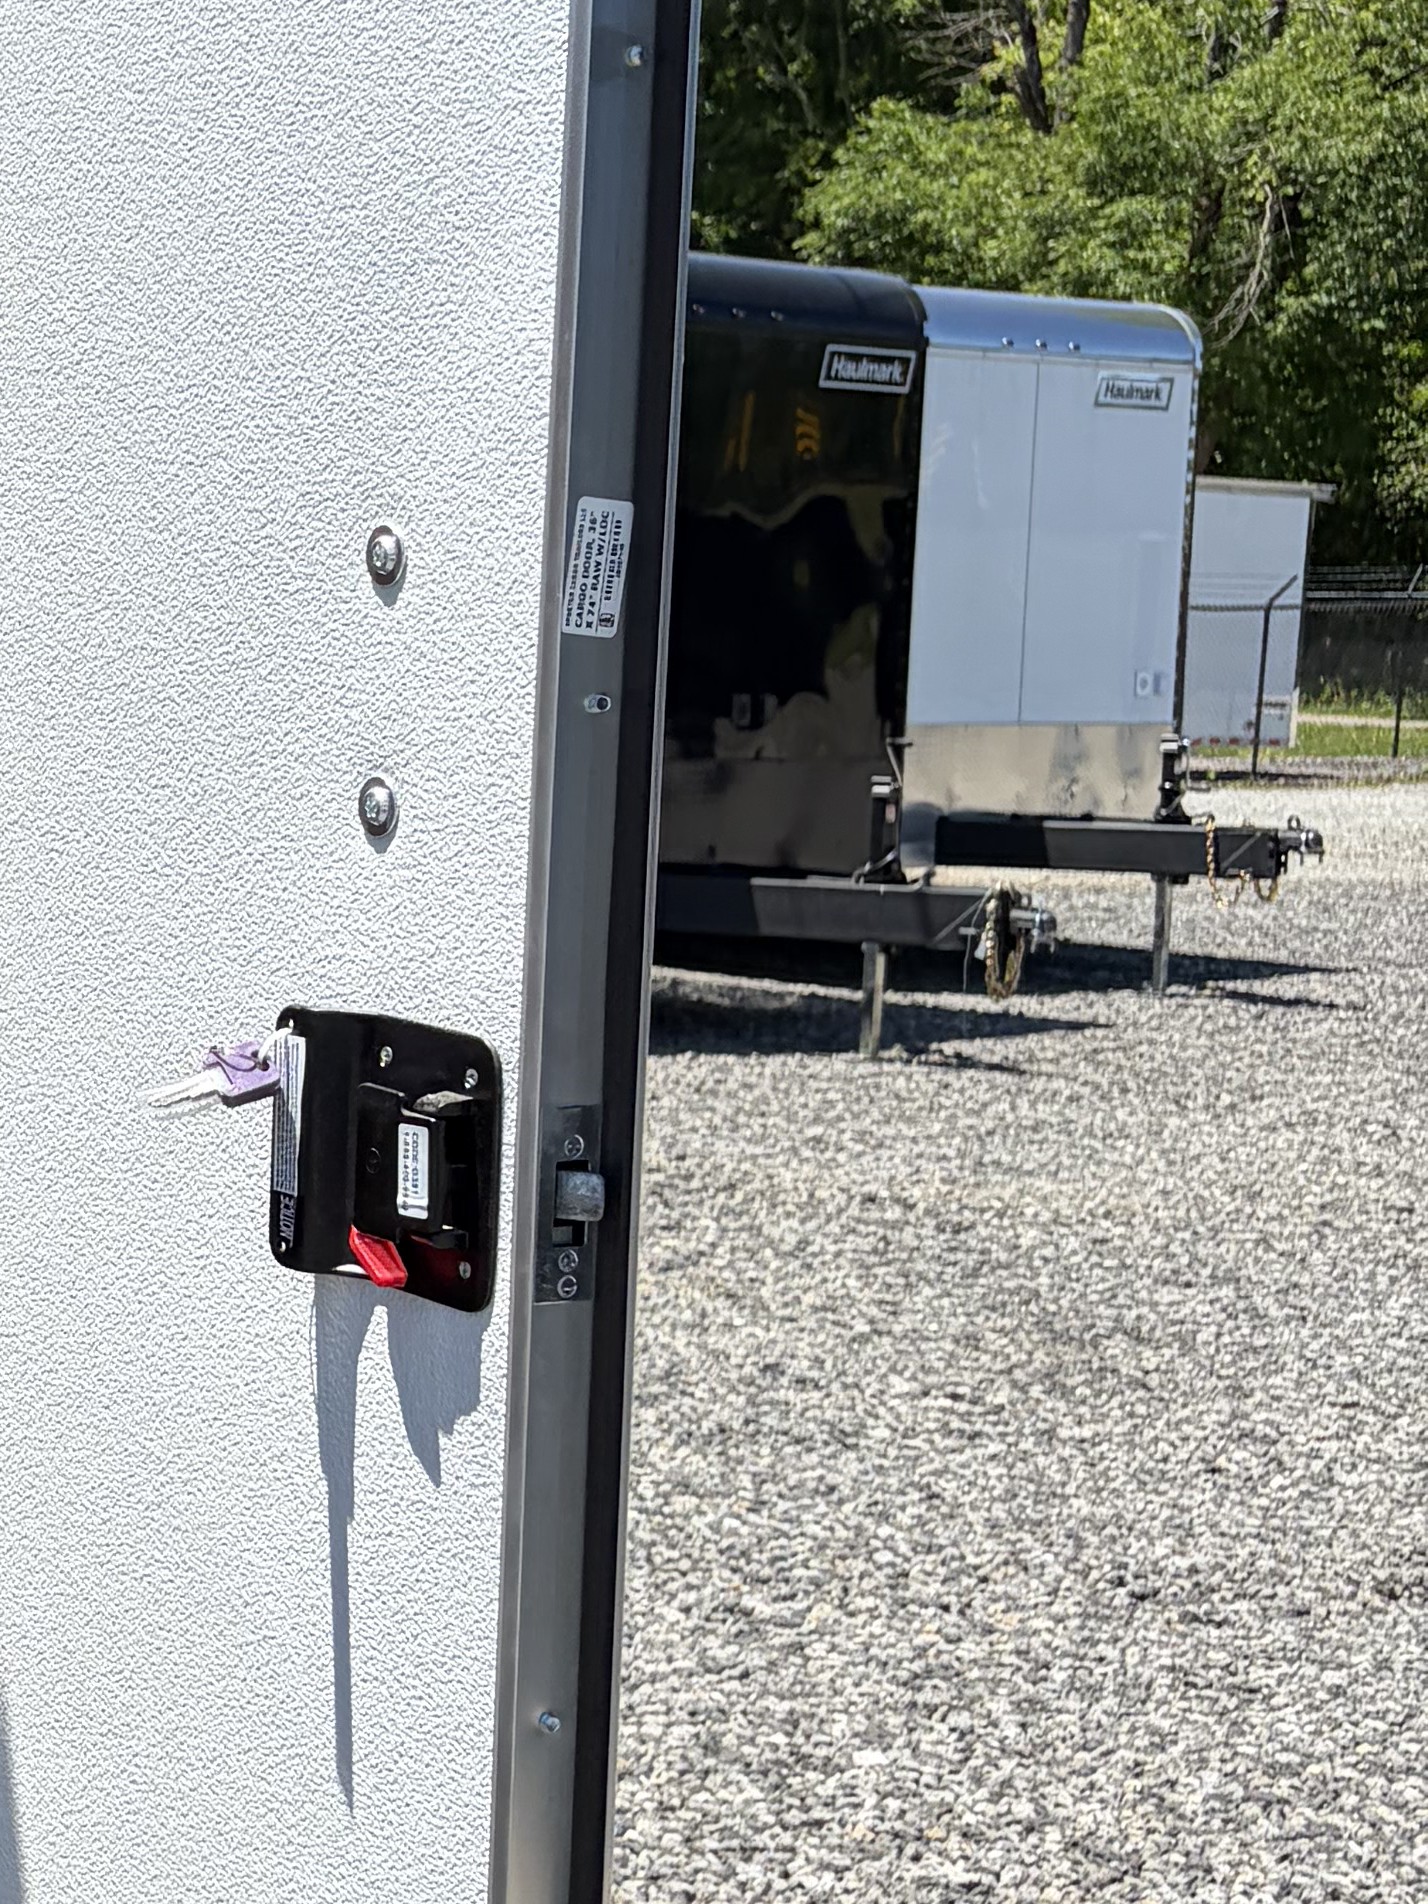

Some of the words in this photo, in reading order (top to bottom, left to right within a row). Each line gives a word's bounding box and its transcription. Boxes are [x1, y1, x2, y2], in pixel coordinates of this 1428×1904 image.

[830, 355, 904, 384] Haulmark
[1104, 381, 1163, 403] Haulmark
[590, 560, 602, 591] RAW
[575, 583, 588, 628] CARGO
